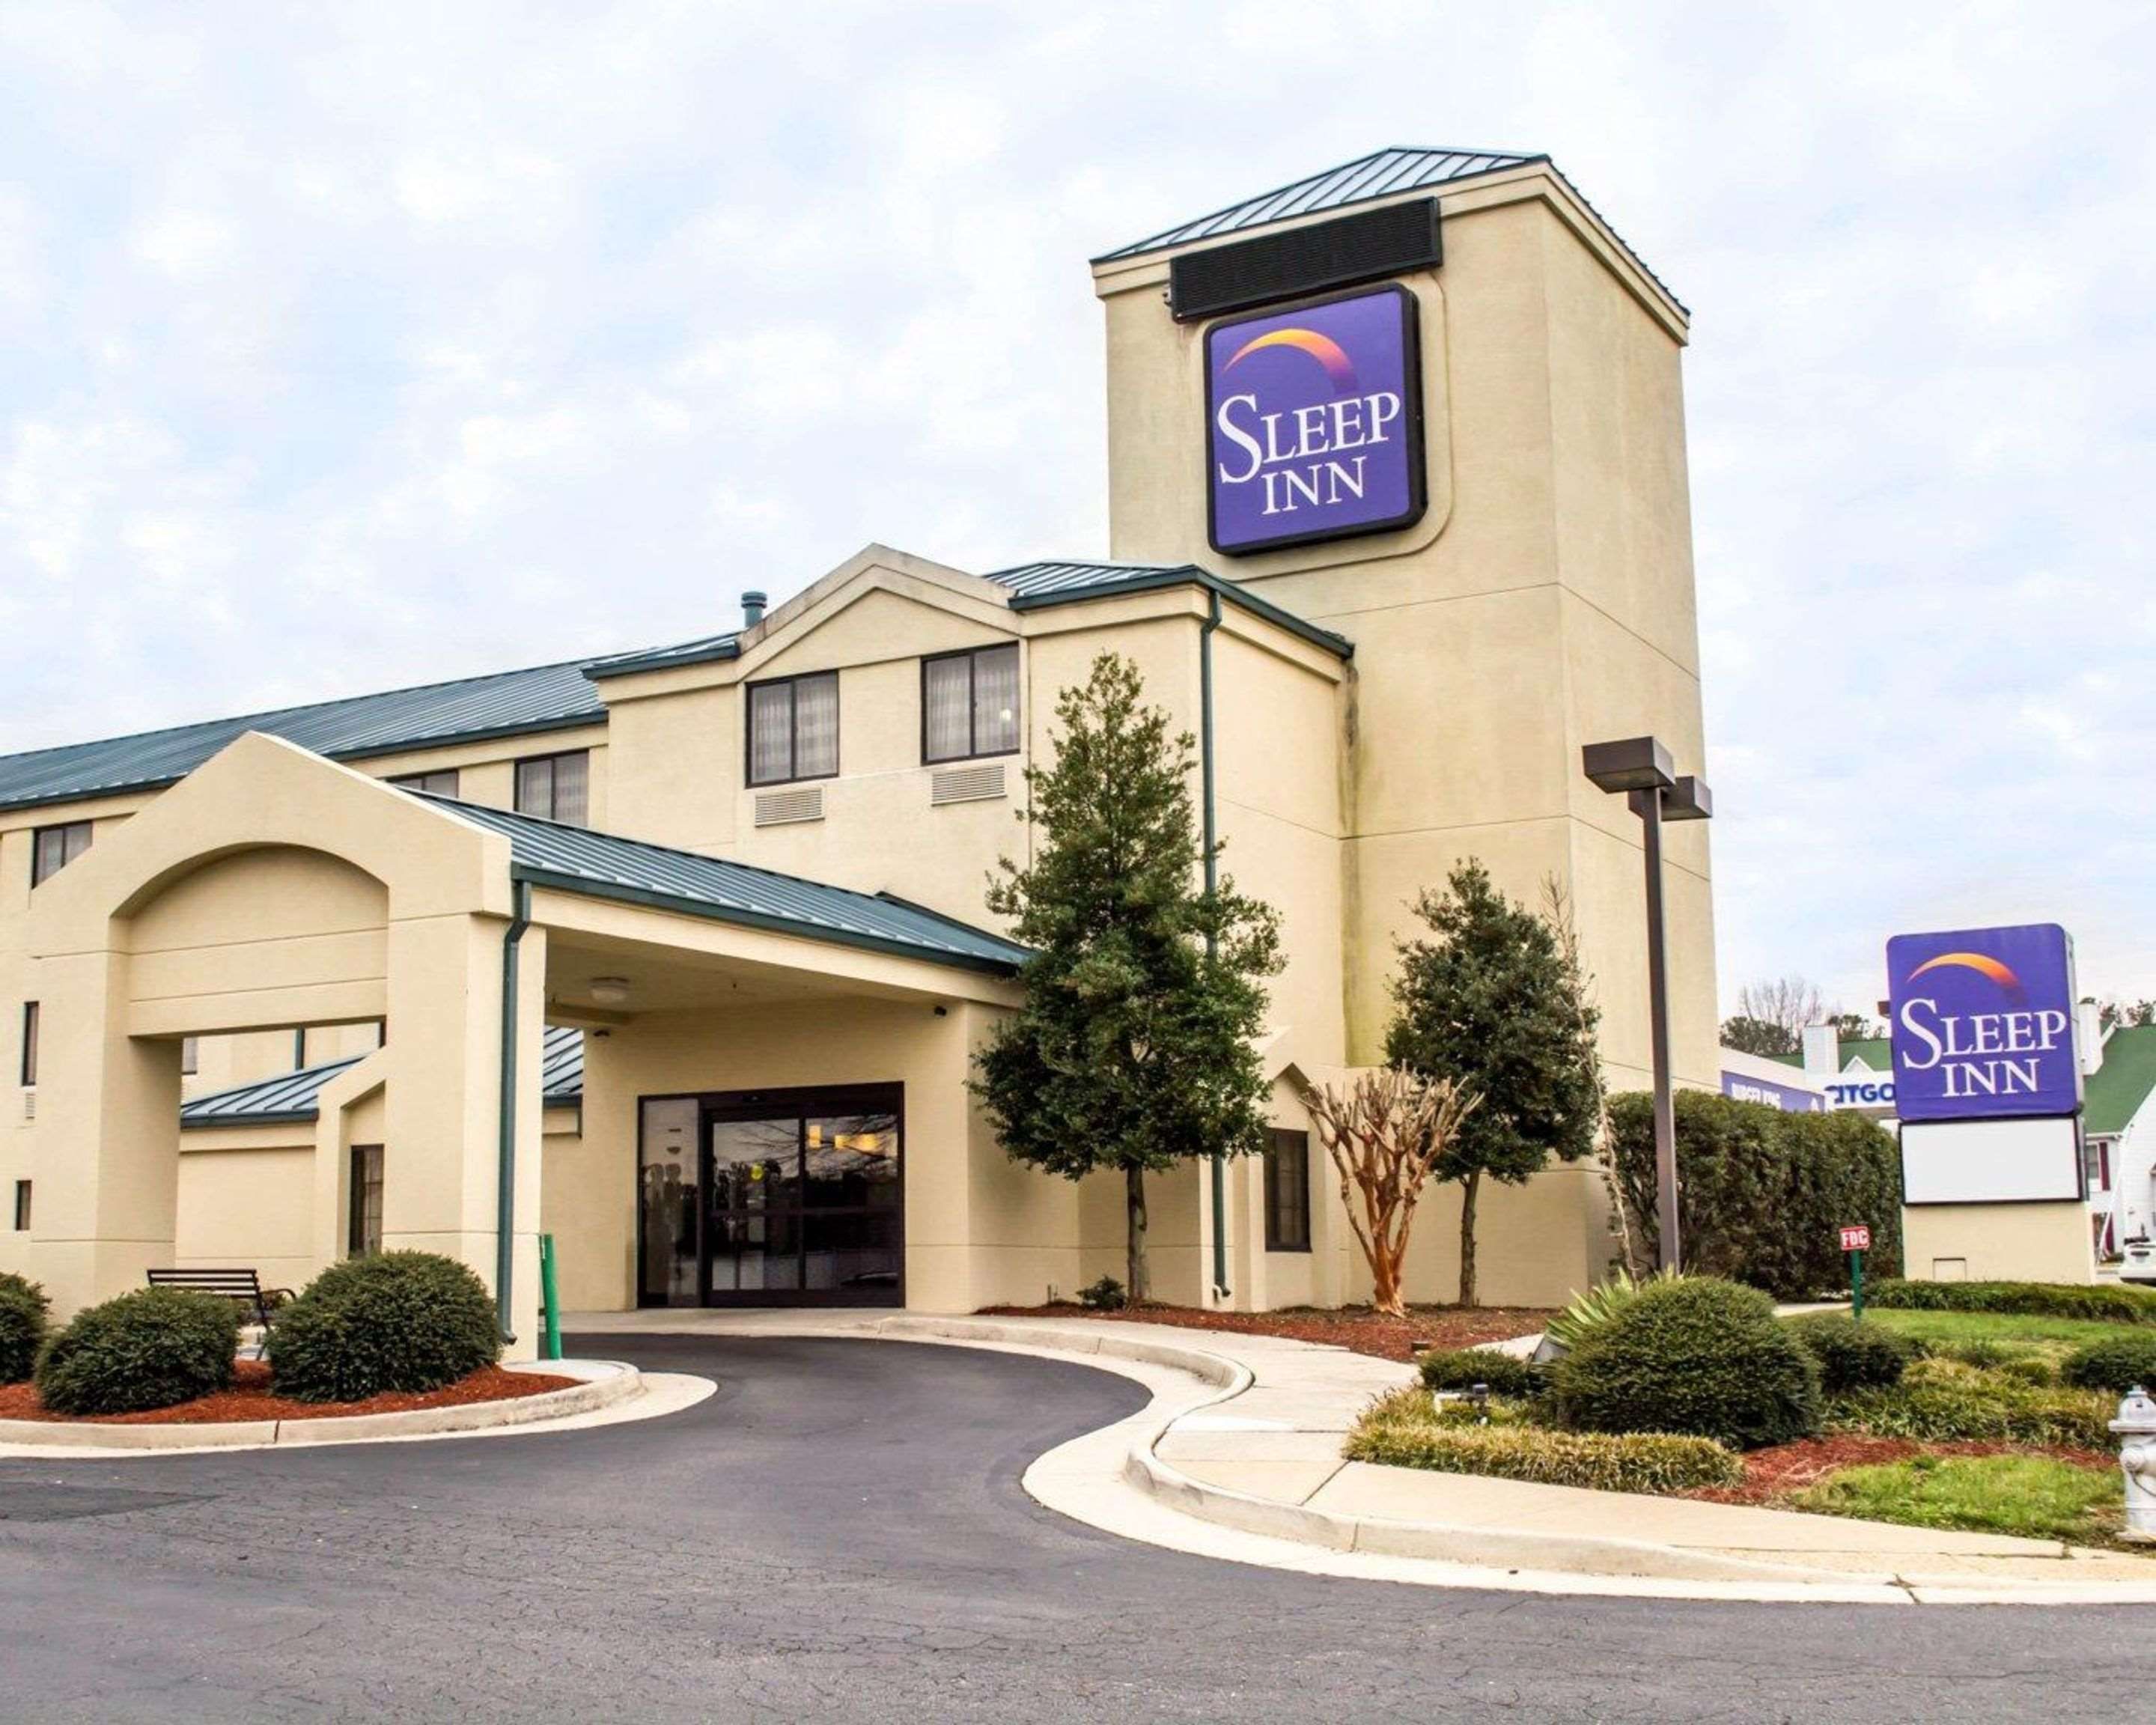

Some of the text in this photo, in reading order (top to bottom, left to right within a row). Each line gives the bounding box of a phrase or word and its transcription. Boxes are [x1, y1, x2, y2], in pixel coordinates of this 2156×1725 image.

[1217, 393, 1400, 483] SLEEP
[1261, 456, 1367, 514] INN
[1900, 998, 2067, 1069] SLEEP
[1942, 1059, 2040, 1098] INN
[1841, 1230, 1869, 1247] FDC
